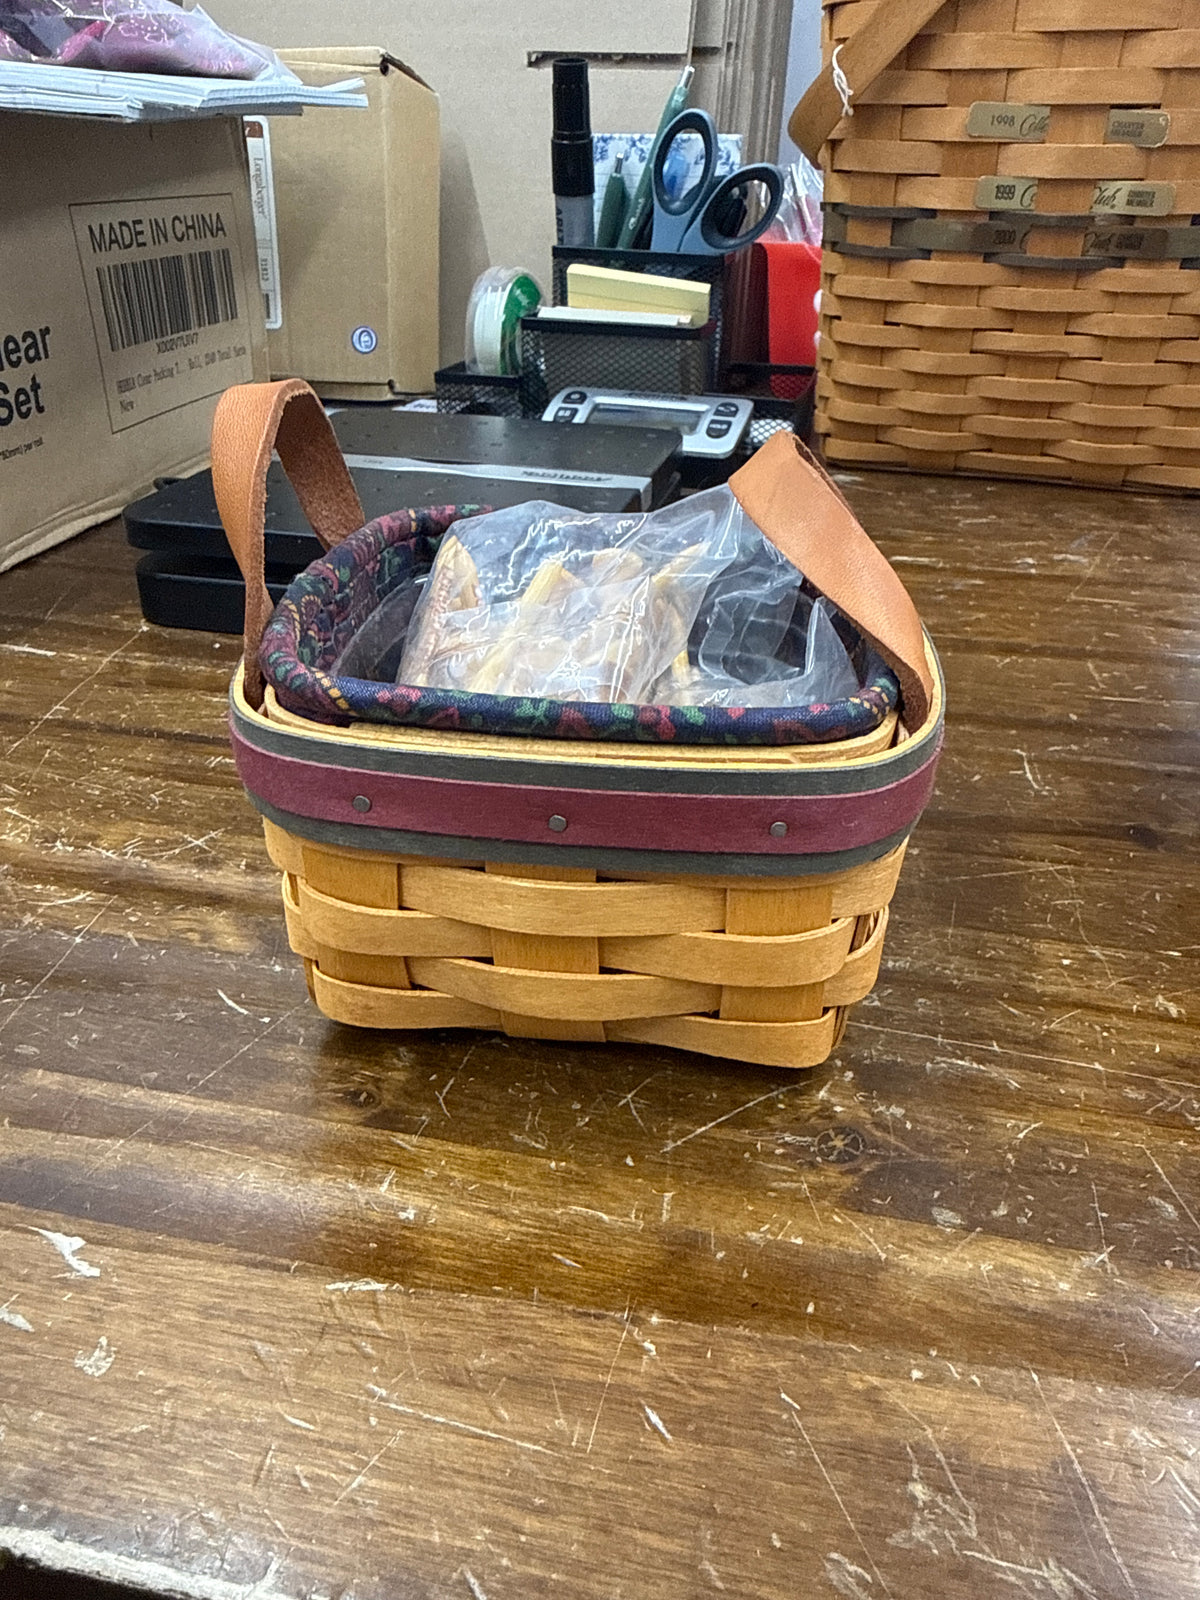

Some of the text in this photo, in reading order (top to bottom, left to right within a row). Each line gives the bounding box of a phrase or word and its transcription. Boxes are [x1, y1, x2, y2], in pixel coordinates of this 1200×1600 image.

[995, 184, 1016, 200] 1999
[88, 212, 227, 253] MADE IN CHINA
[0, 373, 45, 427] Set
